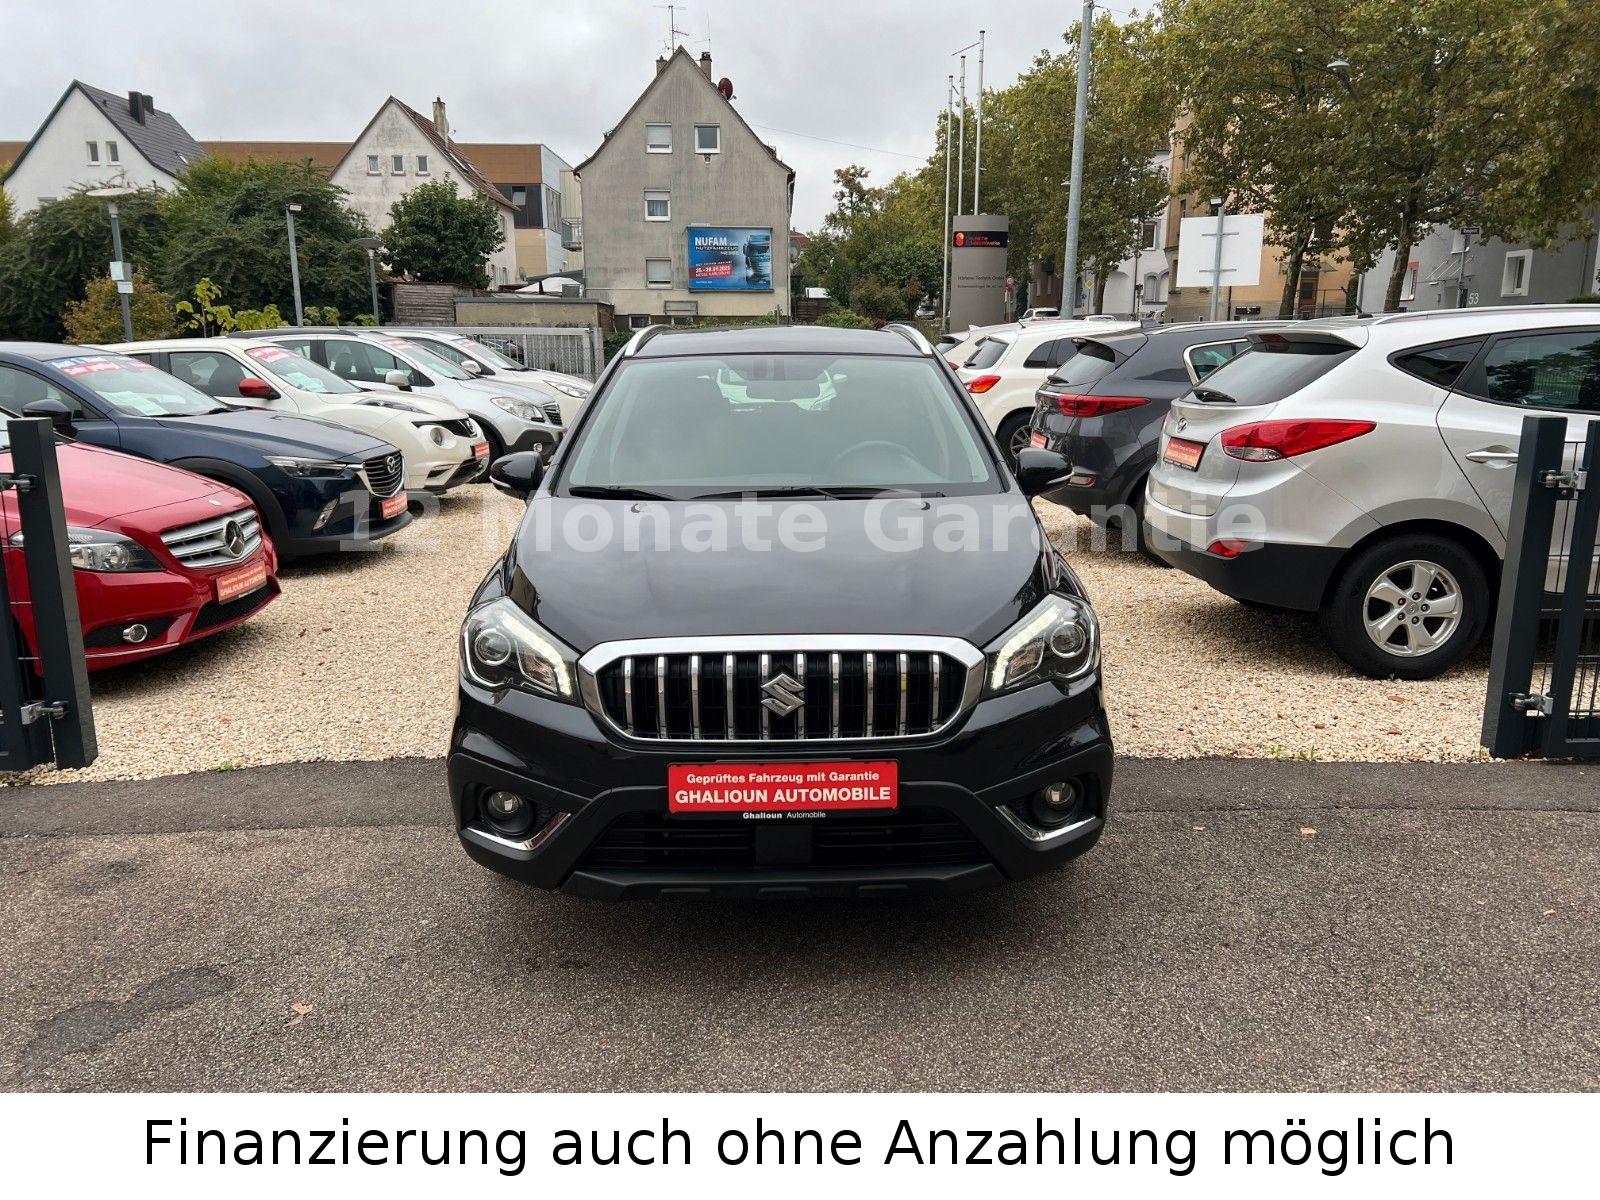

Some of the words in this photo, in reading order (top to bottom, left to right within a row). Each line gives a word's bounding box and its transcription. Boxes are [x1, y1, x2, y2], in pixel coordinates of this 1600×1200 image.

[695, 237, 727, 247] NUFAM
[1468, 292, 1480, 305] 53
[686, 773, 746, 786] Geprüftes
[748, 772, 803, 785] Fahrzeug
[806, 772, 826, 783] mit
[828, 770, 880, 782] Garantie
[675, 789, 768, 805] GHALIOUN
[773, 786, 891, 803] AUTOMOBILE
[742, 811, 783, 820] Ghalioun
[786, 811, 826, 819] Automobile
